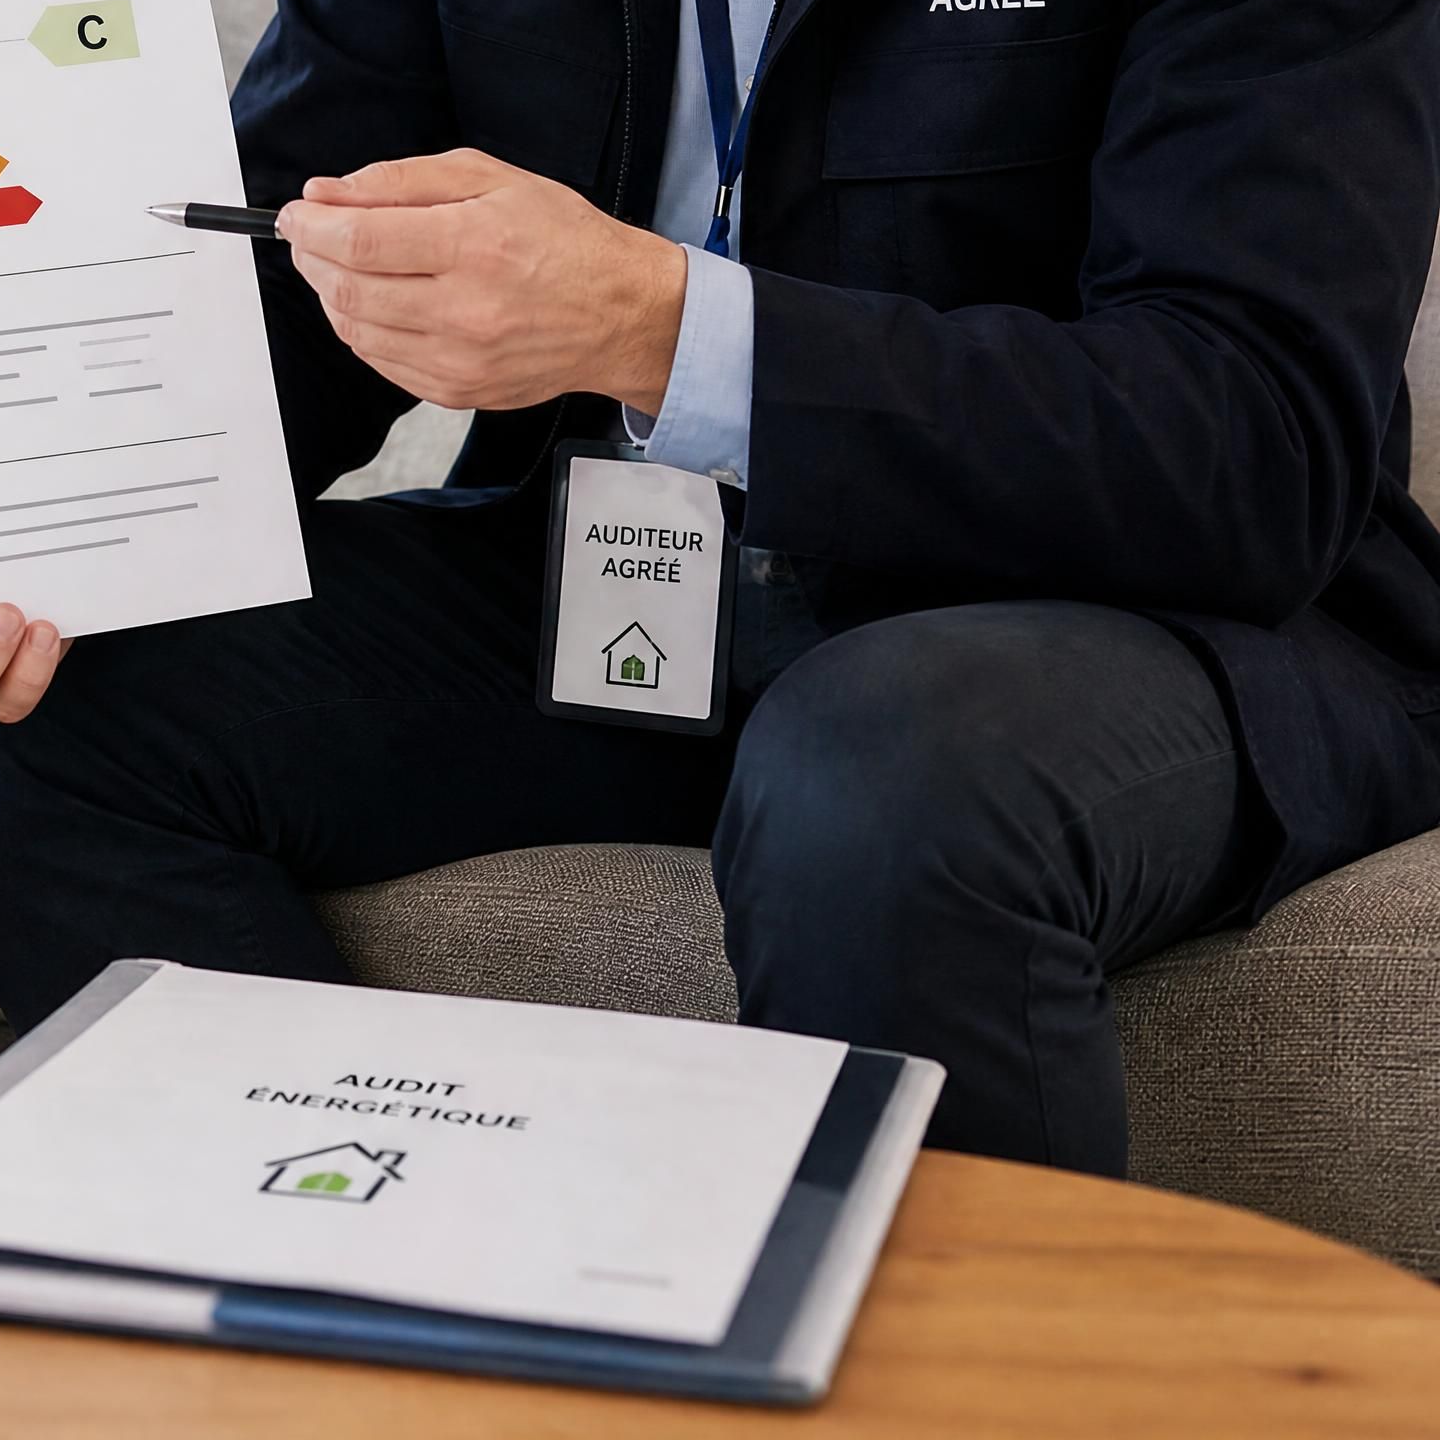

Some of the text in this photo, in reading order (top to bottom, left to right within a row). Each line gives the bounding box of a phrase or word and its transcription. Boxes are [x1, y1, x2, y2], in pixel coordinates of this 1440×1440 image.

[77, 14, 108, 50] C
[585, 523, 703, 553] AUDITEUR
[600, 556, 682, 584] AGRÉÉ
[333, 1073, 465, 1097] AUDIT
[244, 1086, 531, 1131] ÉNERGÉTIQUE
